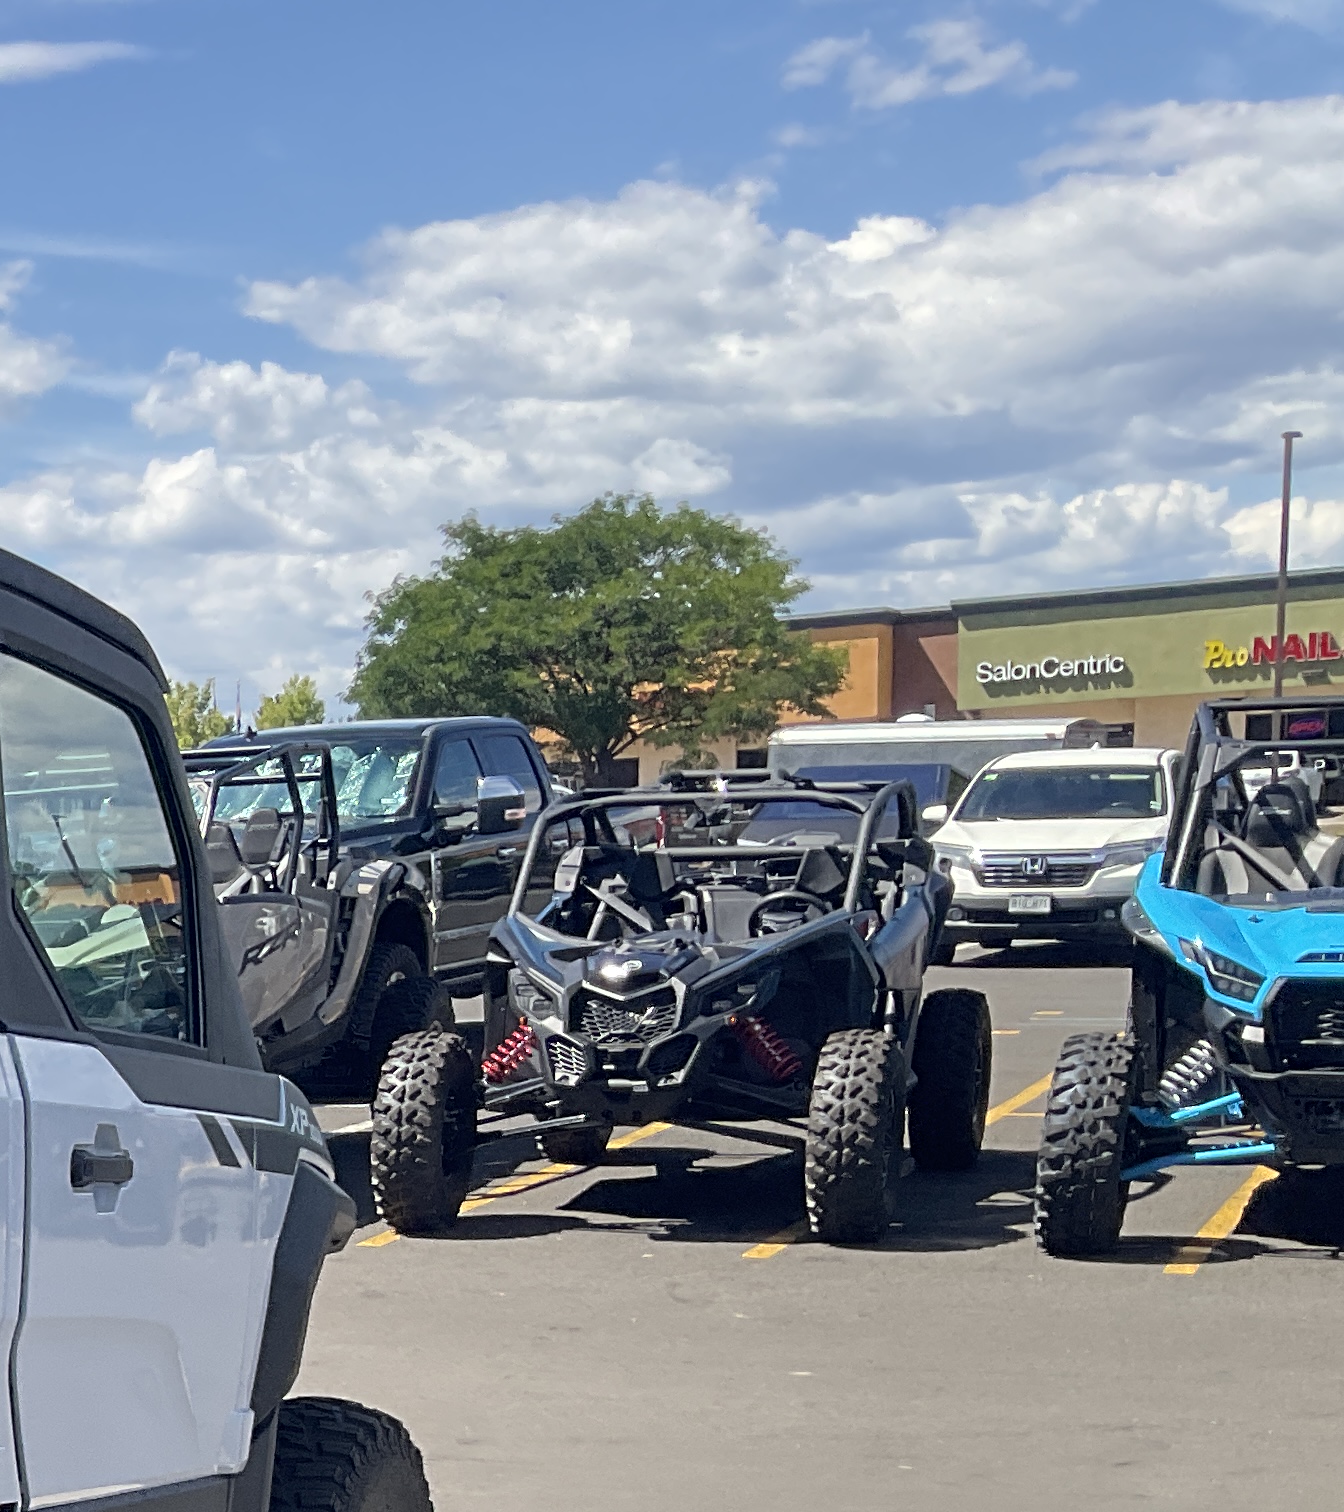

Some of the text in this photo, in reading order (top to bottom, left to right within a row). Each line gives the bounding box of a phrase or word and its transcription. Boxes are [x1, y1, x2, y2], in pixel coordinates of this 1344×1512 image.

[1203, 632, 1344, 668] Pro NAIL
[976, 653, 1125, 684] SalonCentric
